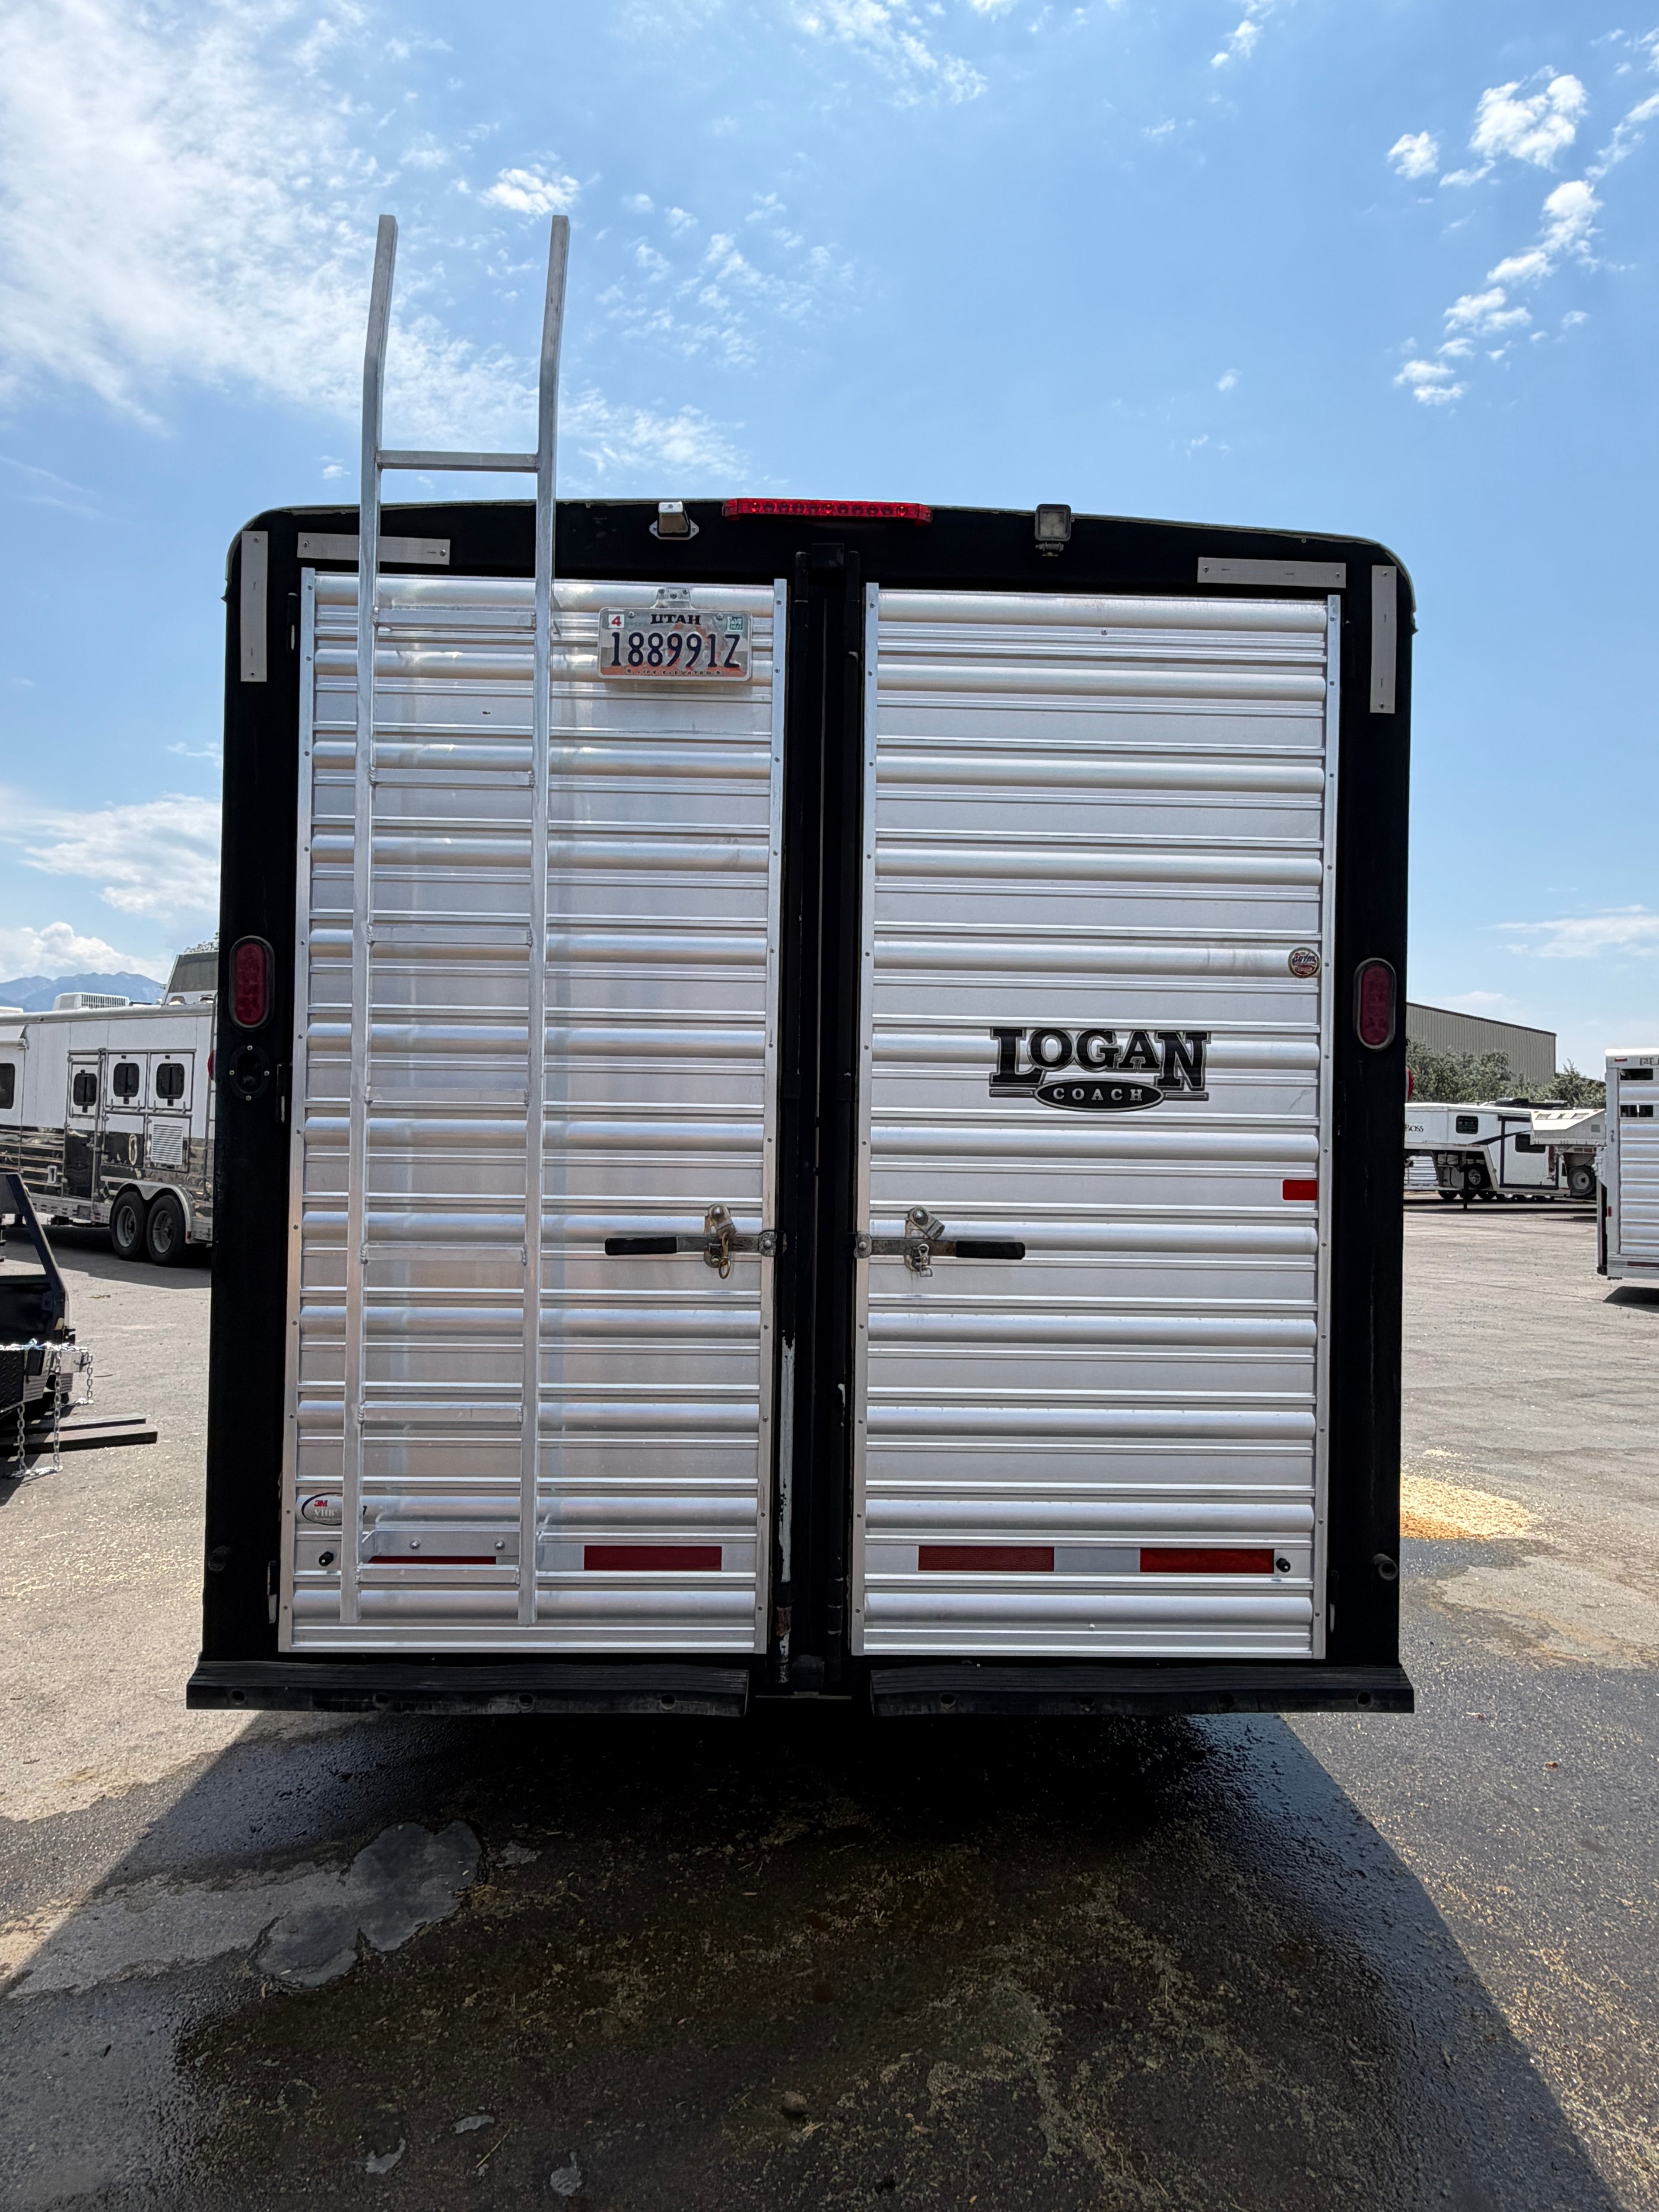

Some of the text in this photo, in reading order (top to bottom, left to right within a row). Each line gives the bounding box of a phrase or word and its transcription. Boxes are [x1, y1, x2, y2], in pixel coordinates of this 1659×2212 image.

[611, 616, 622, 626] 4
[650, 614, 701, 625] UTAH
[611, 632, 740, 668] 188991Z
[990, 1027, 1211, 1091] LOGAN
[1053, 1088, 1143, 1101] COACH
